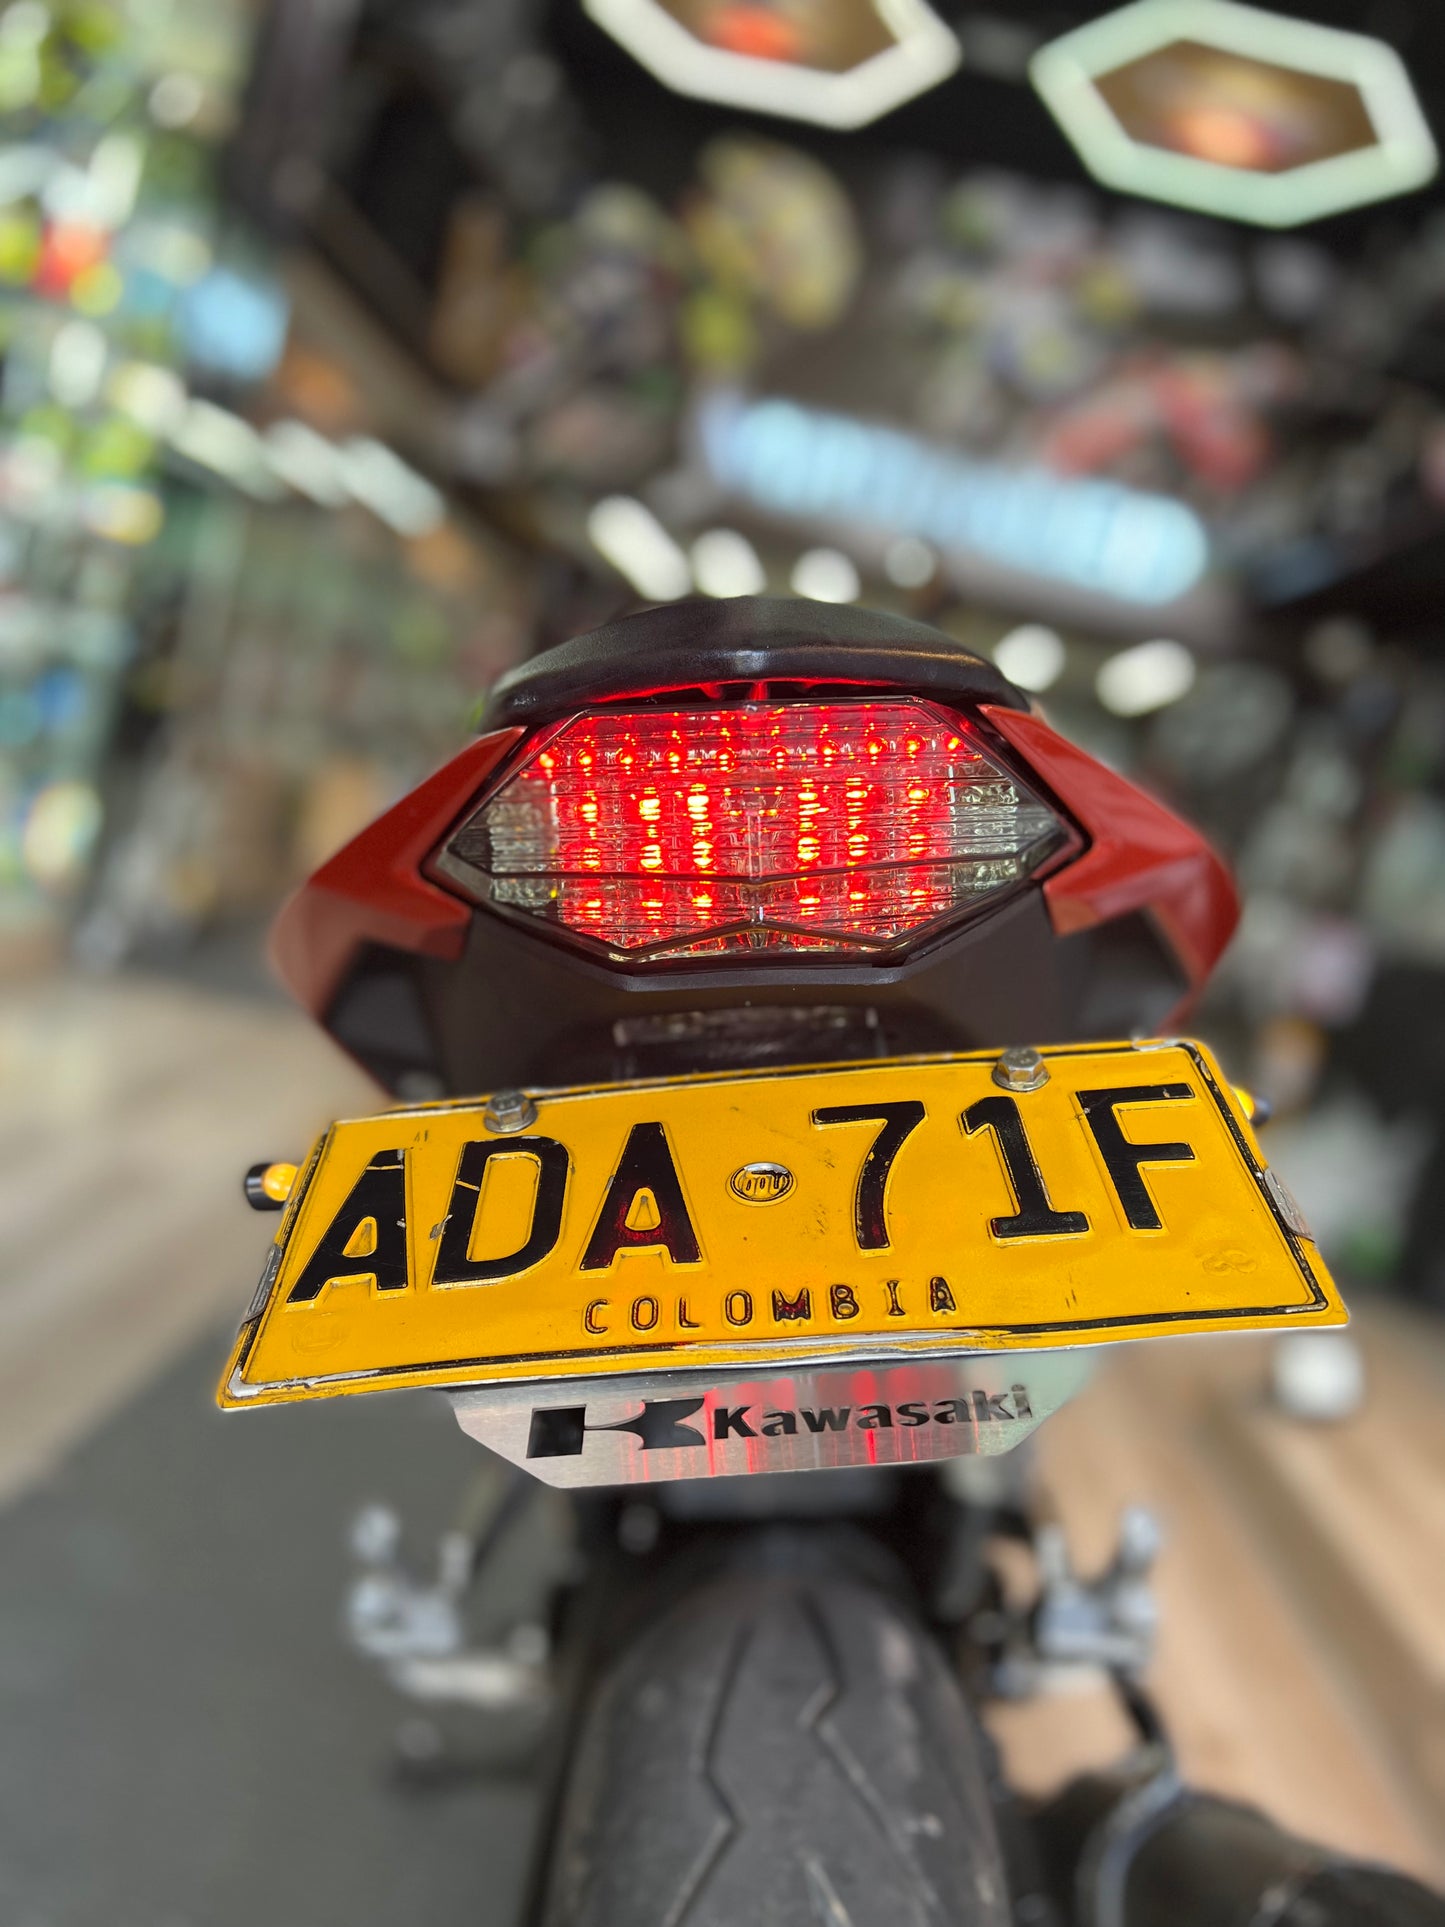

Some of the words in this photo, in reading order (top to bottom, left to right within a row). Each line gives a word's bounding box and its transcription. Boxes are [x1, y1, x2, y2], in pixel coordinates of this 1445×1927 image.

[287, 1121, 703, 1303] ADA
[812, 1082, 1196, 1251] 71F
[584, 1276, 957, 1335] COLOMBIA
[713, 1383, 1034, 1440] Kawasaki
